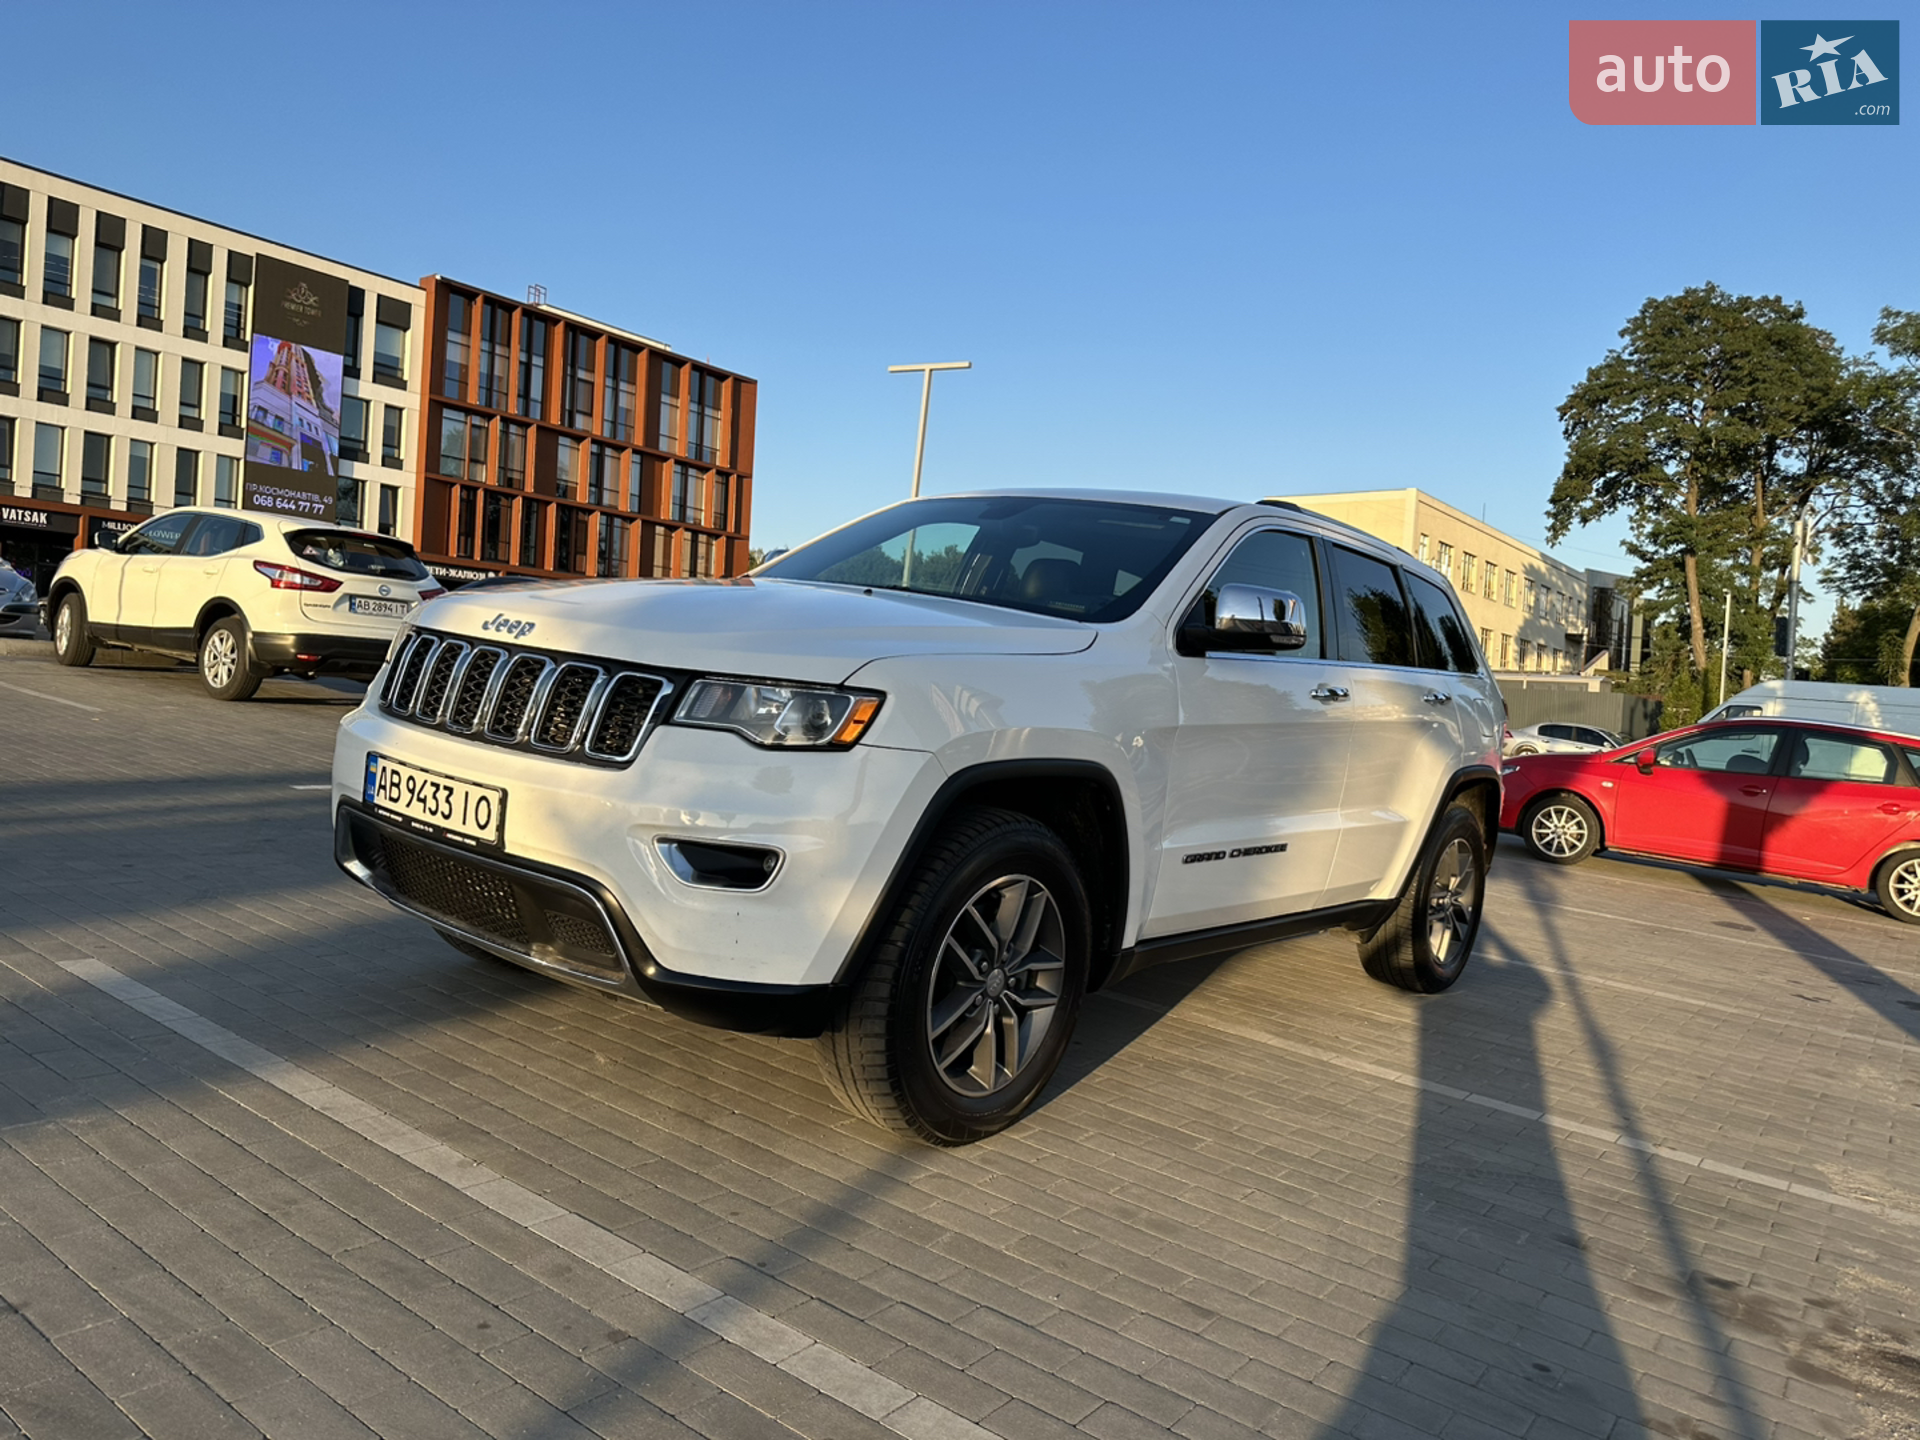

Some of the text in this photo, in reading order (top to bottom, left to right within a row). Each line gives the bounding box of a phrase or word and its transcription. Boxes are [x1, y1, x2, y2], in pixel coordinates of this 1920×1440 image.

[253, 494, 325, 516] 068 644 77 77
[322, 495, 334, 505] 49
[2, 507, 48, 525] VATSAK
[357, 600, 406, 615] AB 2894 IT
[481, 613, 536, 640] Jeep
[376, 766, 492, 831] AB 9433 IO
[1182, 843, 1288, 864] GRAND CHEROKEE
